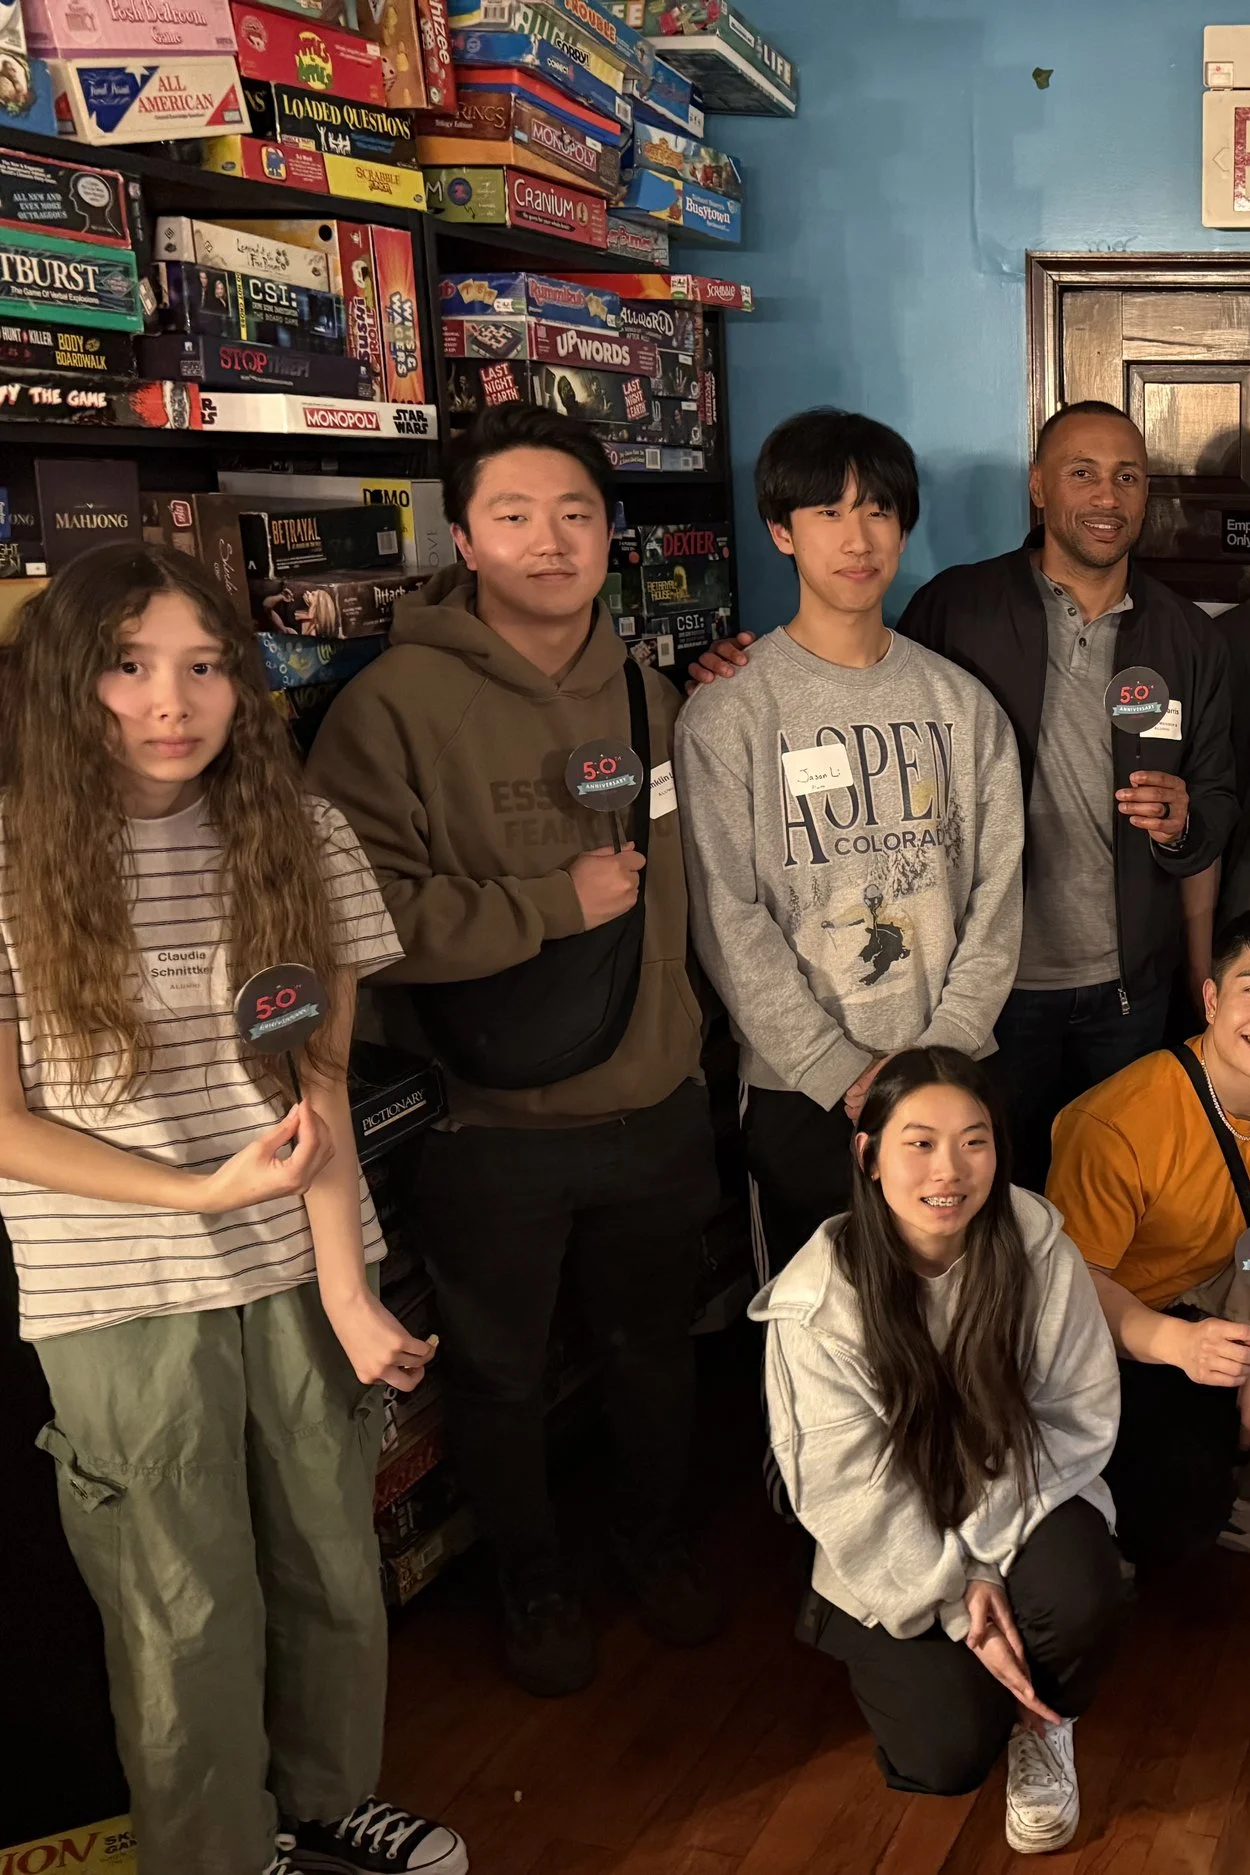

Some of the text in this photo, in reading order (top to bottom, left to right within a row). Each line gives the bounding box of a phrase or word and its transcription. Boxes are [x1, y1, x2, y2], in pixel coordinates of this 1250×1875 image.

[763, 44, 792, 88] LIFE
[158, 75, 186, 93] ALL
[138, 93, 215, 115] AMERICAN
[282, 93, 342, 126] LOADED
[343, 104, 412, 140] QUESTIONS
[531, 122, 597, 169] MONOPOLY
[356, 167, 400, 186] SCRABBLE
[17, 211, 68, 220] OUTRAGEOUS
[685, 196, 731, 224] Busytown
[10, 286, 23, 295] The
[23, 287, 42, 297] Game
[248, 278, 298, 308] CSI:
[2, 326, 53, 346] HUNT KILLER
[57, 333, 84, 353] BODY
[55, 350, 107, 370] BOARDWALK
[219, 345, 268, 374] STOP
[480, 363, 511, 382] LAST
[484, 374, 514, 394] NIGHT
[623, 379, 641, 396] LAST
[28, 387, 62, 406] THE
[66, 390, 108, 408] GAME
[304, 409, 379, 431] MONOPOLY
[393, 409, 428, 422] STAR
[394, 421, 429, 434] WARS
[55, 512, 129, 529] MAHJONG
[271, 517, 321, 551] BETRAYAL
[662, 529, 715, 557] DEXTER
[676, 613, 706, 632] CSI:
[585, 776, 627, 790] ANNIVERSARY
[796, 766, 842, 784] Jason Li
[779, 721, 953, 868] ASPEN
[833, 828, 948, 856] COLORAD
[158, 950, 207, 962] Claudia
[361, 1088, 426, 1132] PICTIONARY
